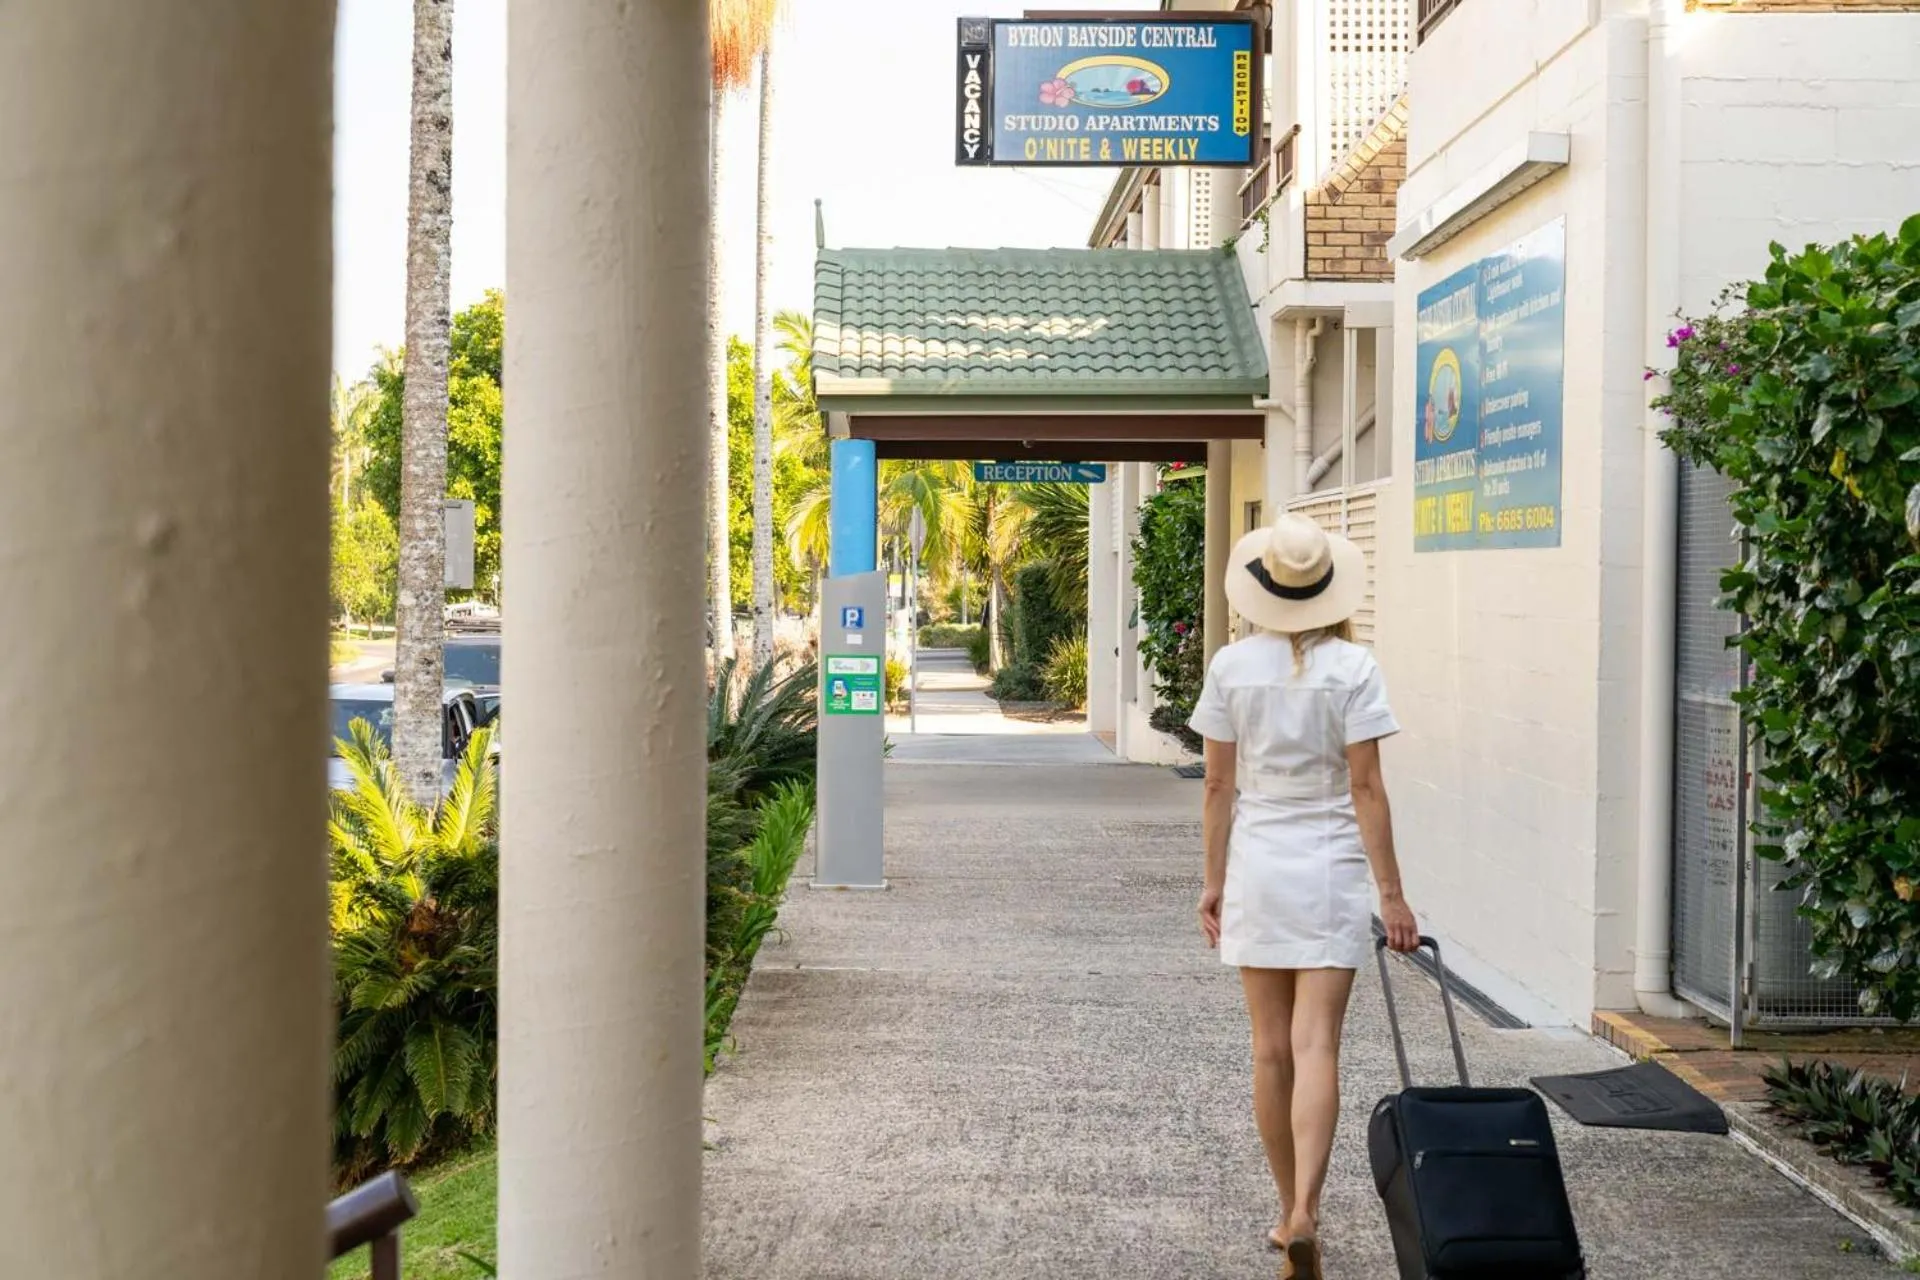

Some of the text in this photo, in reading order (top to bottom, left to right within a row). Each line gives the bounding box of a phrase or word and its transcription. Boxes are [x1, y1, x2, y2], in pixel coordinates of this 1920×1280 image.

[1007, 26, 1217, 48] BYRON BAYSIDE CENTRAL
[1235, 53, 1248, 134] RECEPTION
[963, 54, 982, 159] VACANCY
[1004, 114, 1220, 132] STUDIO APARTMENTS
[1024, 137, 1199, 161] O'NITE & WEEKLY
[983, 465, 1072, 481] RECEPTION
[1496, 509, 1524, 531] 6685
[1525, 505, 1555, 530] 6004
